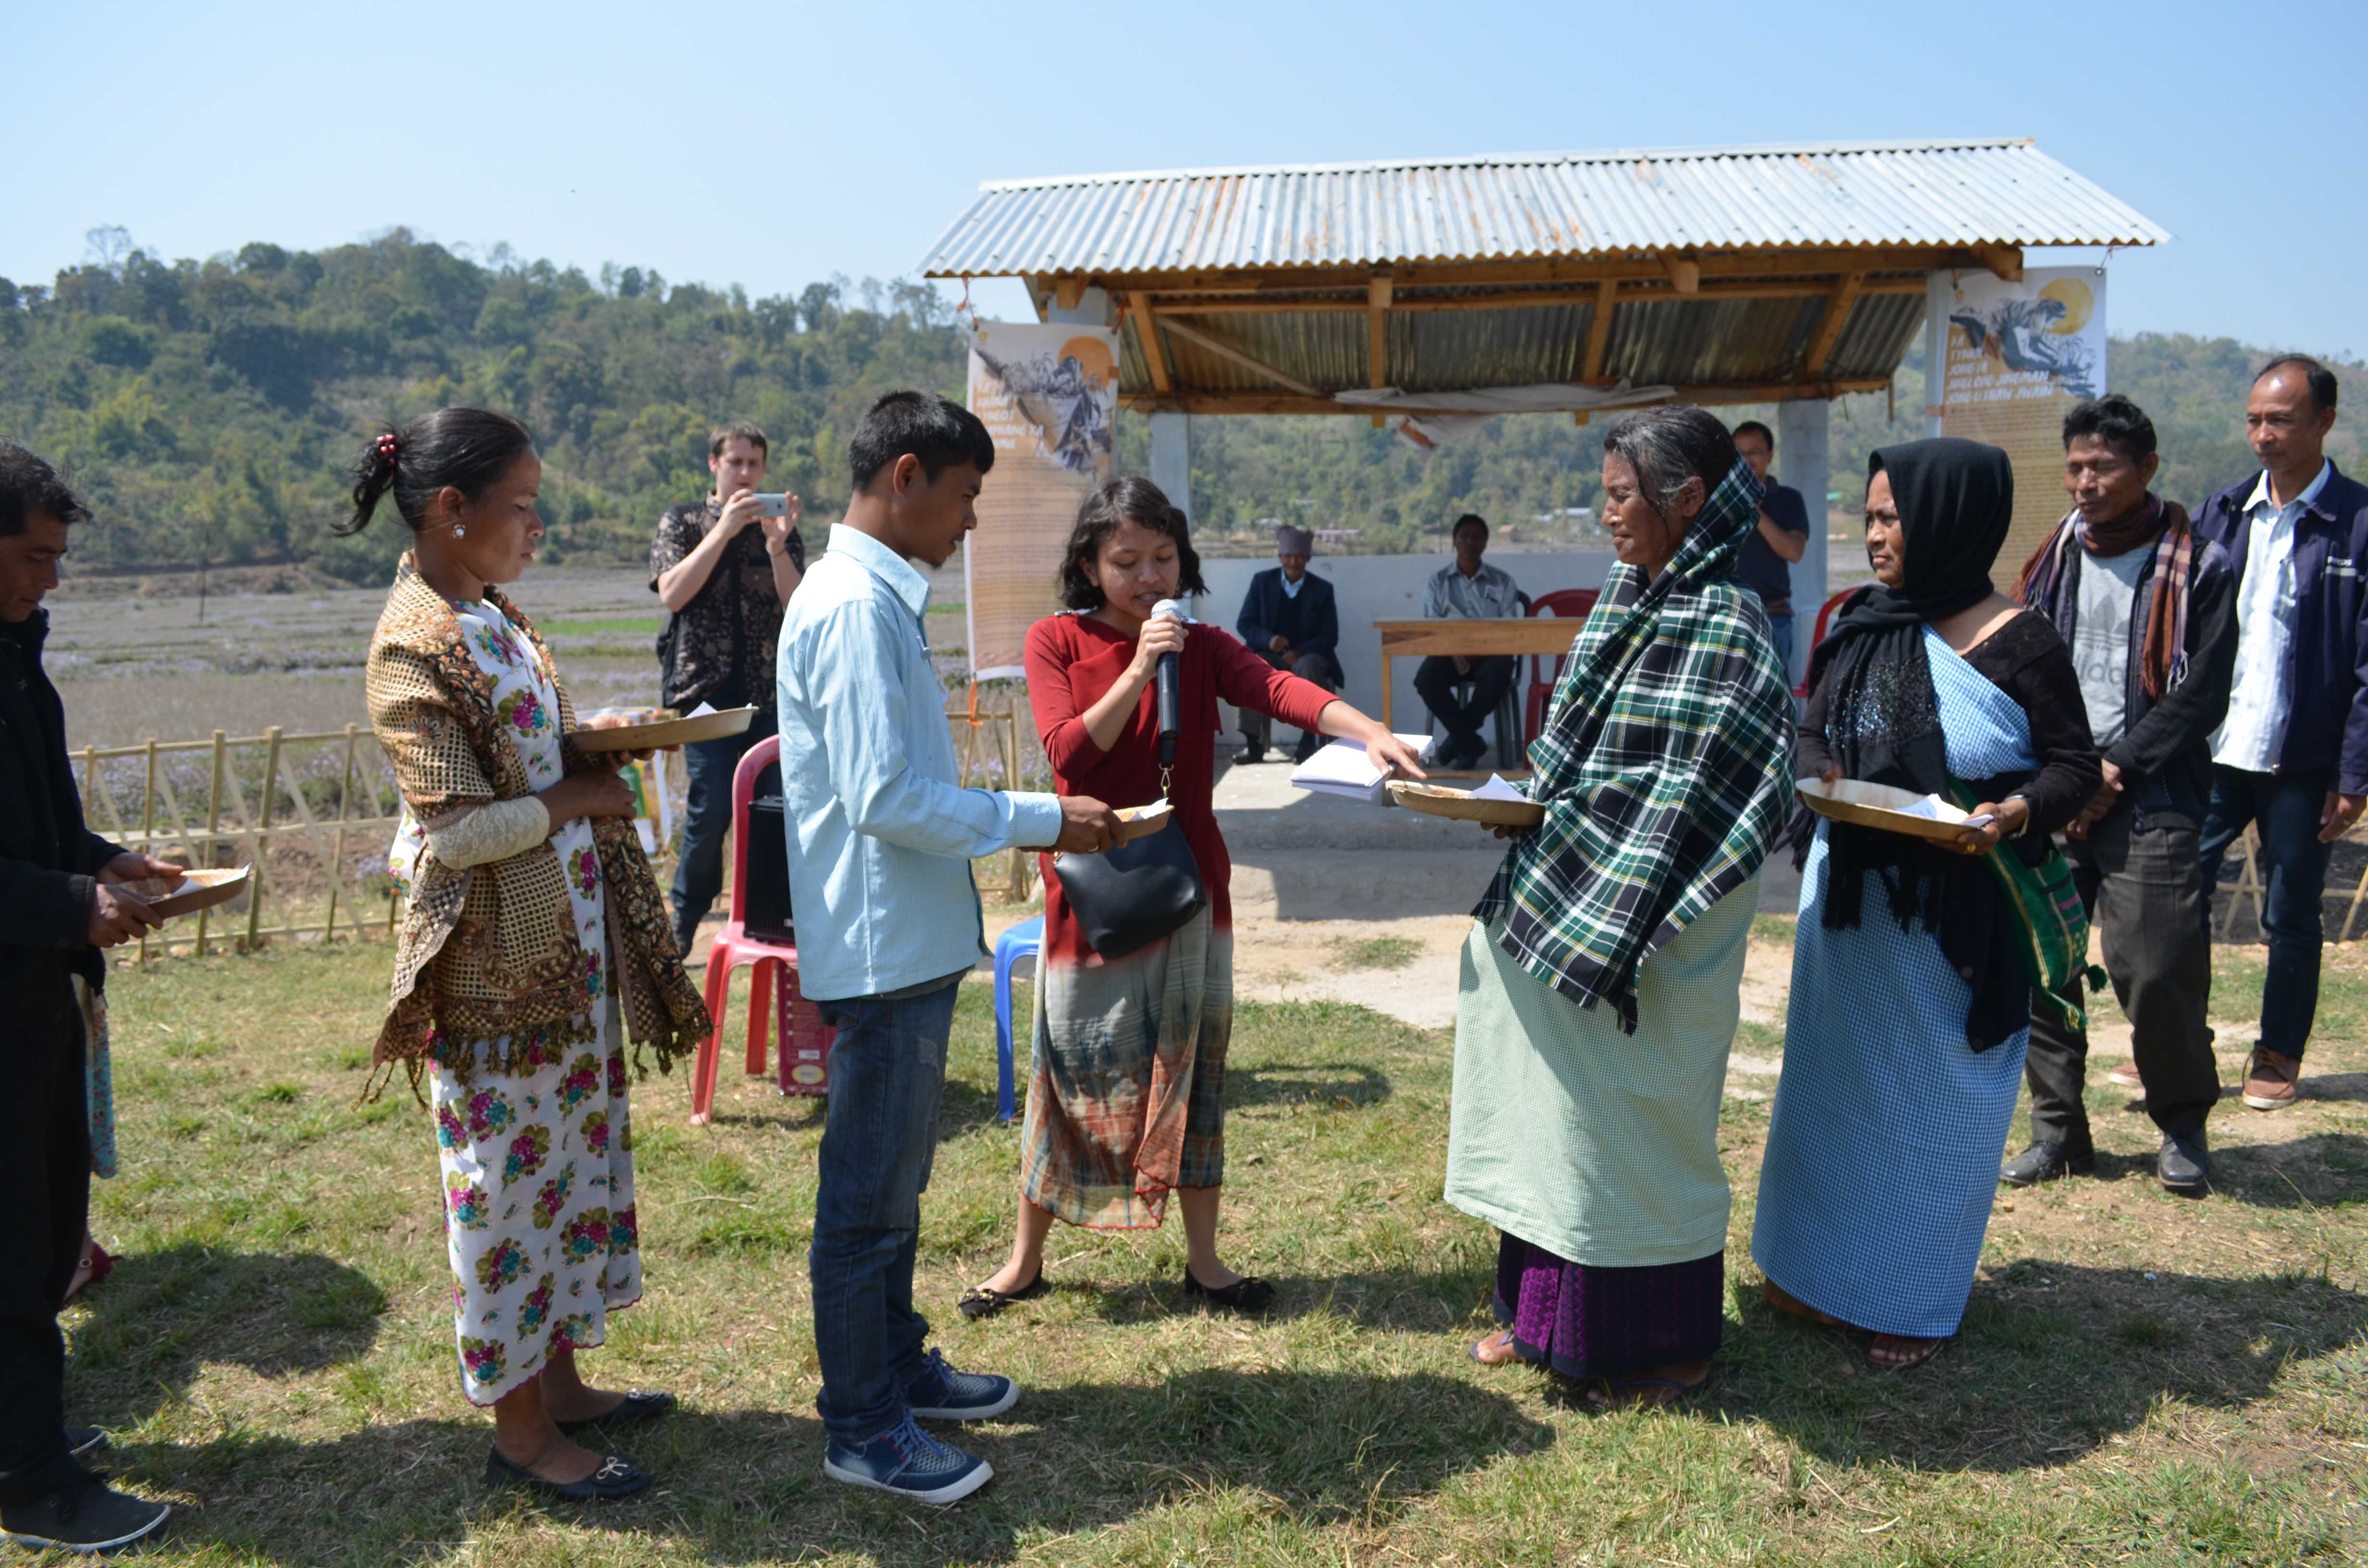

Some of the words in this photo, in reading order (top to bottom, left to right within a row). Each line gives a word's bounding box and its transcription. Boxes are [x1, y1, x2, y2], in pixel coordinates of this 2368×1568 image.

[1948, 364, 1974, 375] JONG
[1995, 370, 2049, 386] JINGMAN
[1946, 391, 1973, 404] JONG
